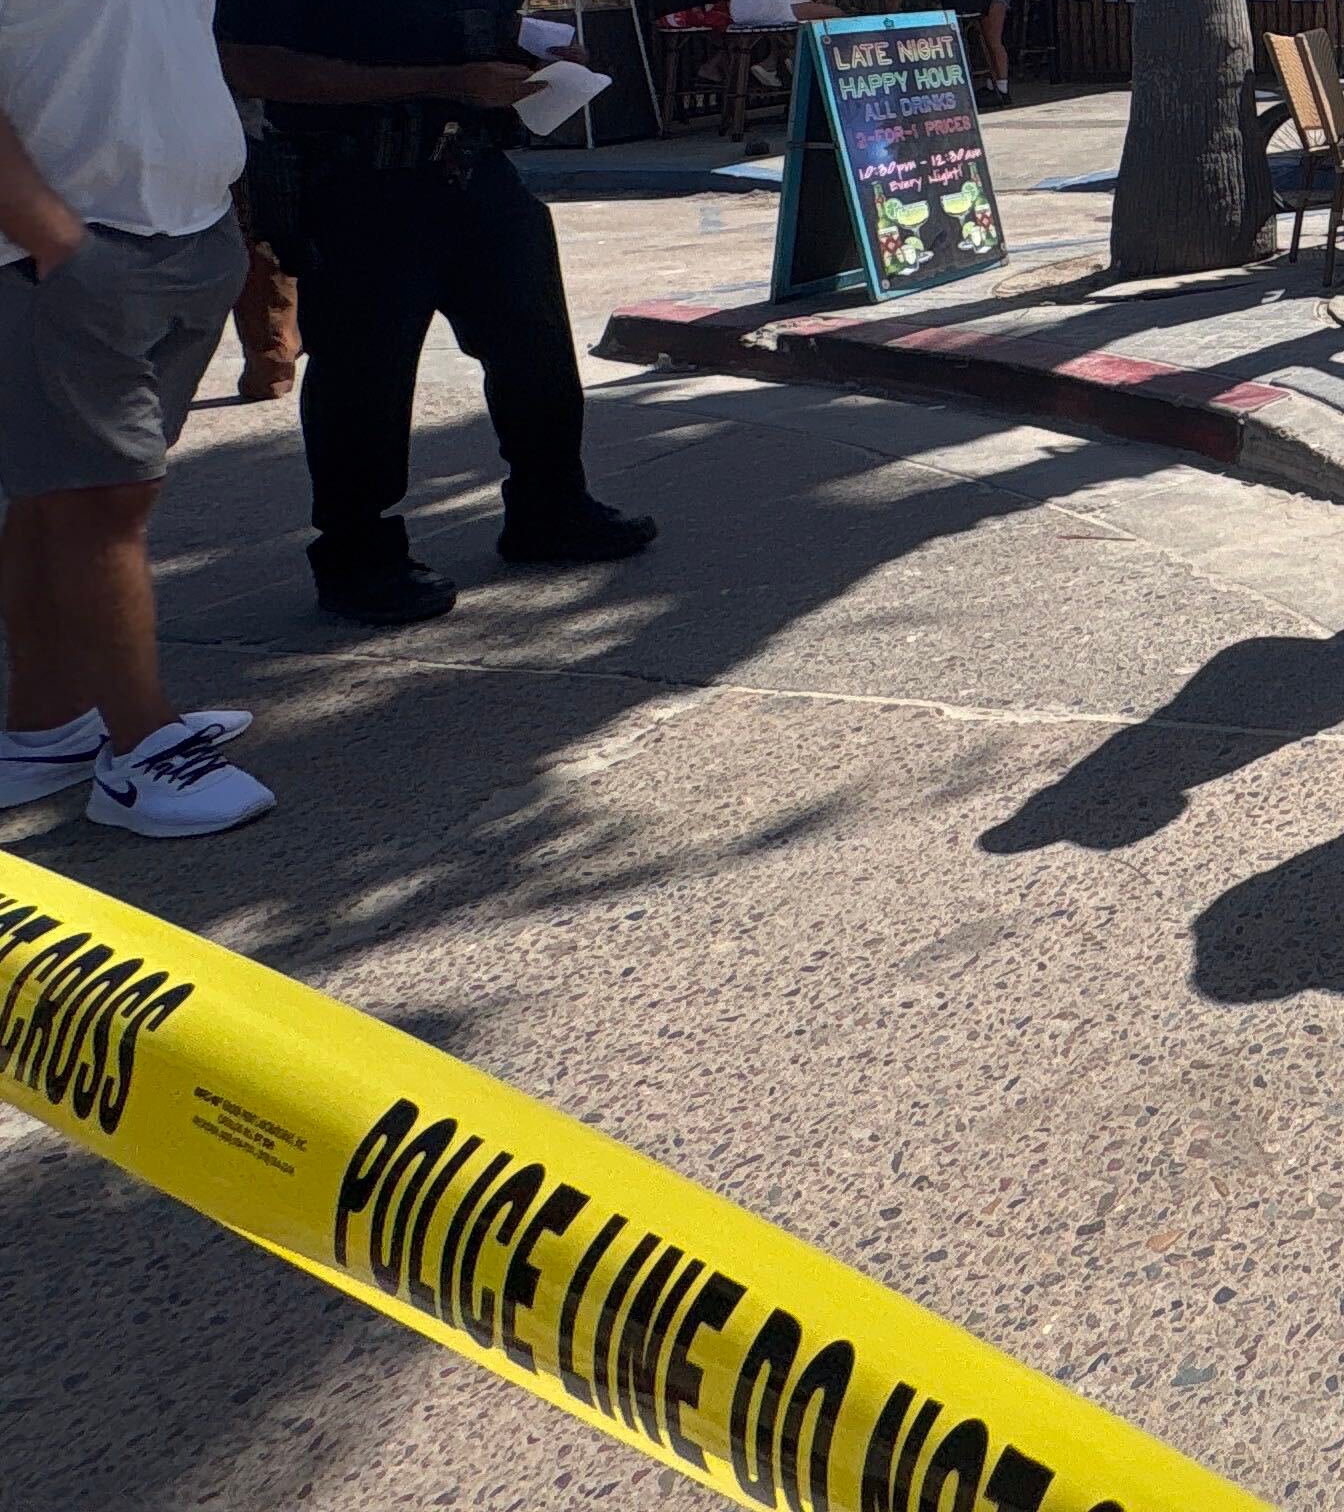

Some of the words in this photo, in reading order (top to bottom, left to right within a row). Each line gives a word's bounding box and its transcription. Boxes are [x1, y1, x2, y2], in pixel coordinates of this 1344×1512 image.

[833, 41, 893, 71] LATE
[896, 35, 954, 64] NIGHT
[838, 71, 908, 101] HAPPY
[914, 64, 965, 91] HOUR
[865, 100, 897, 122] ALL
[900, 91, 957, 117] DRINKS
[924, 115, 972, 137] PRICES
[334, 1098, 592, 1378] POLICE
[558, 1212, 749, 1476] LINE
[729, 1307, 856, 1512] DO
